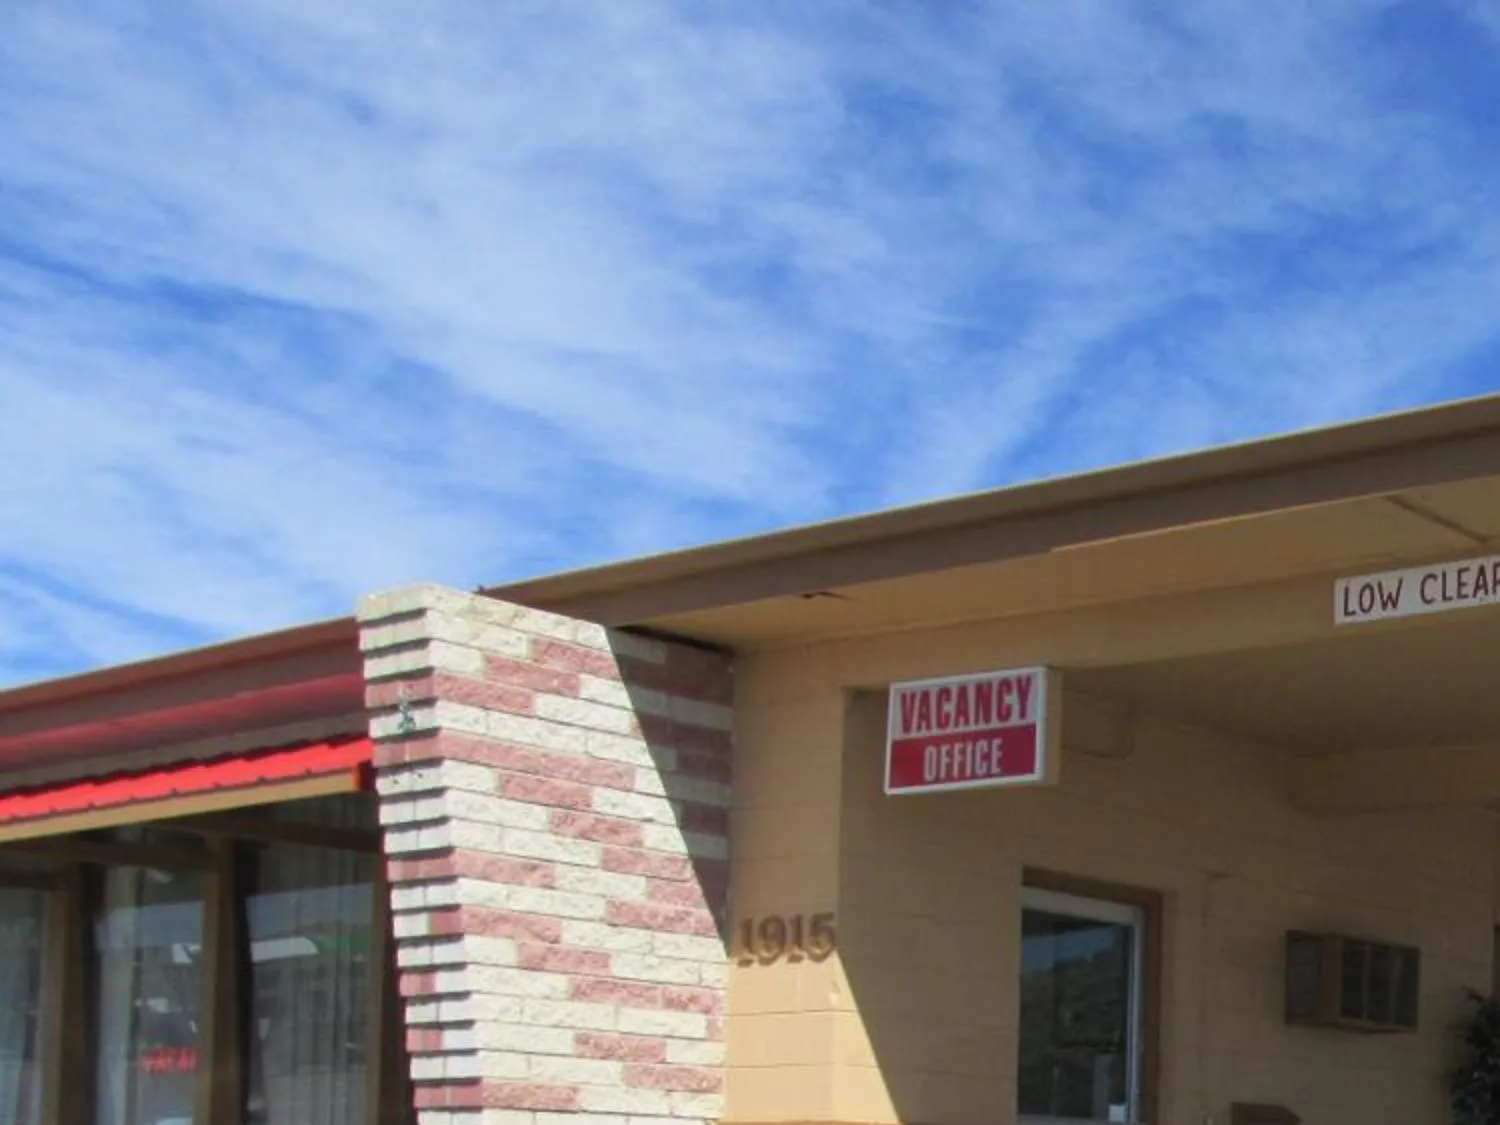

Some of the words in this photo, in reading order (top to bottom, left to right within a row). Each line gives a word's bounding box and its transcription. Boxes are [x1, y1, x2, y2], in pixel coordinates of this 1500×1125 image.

[1343, 577, 1403, 618] LOW
[901, 674, 1032, 735] VACANCY
[924, 738, 1003, 783] OFFICE
[737, 912, 836, 968] 1915
